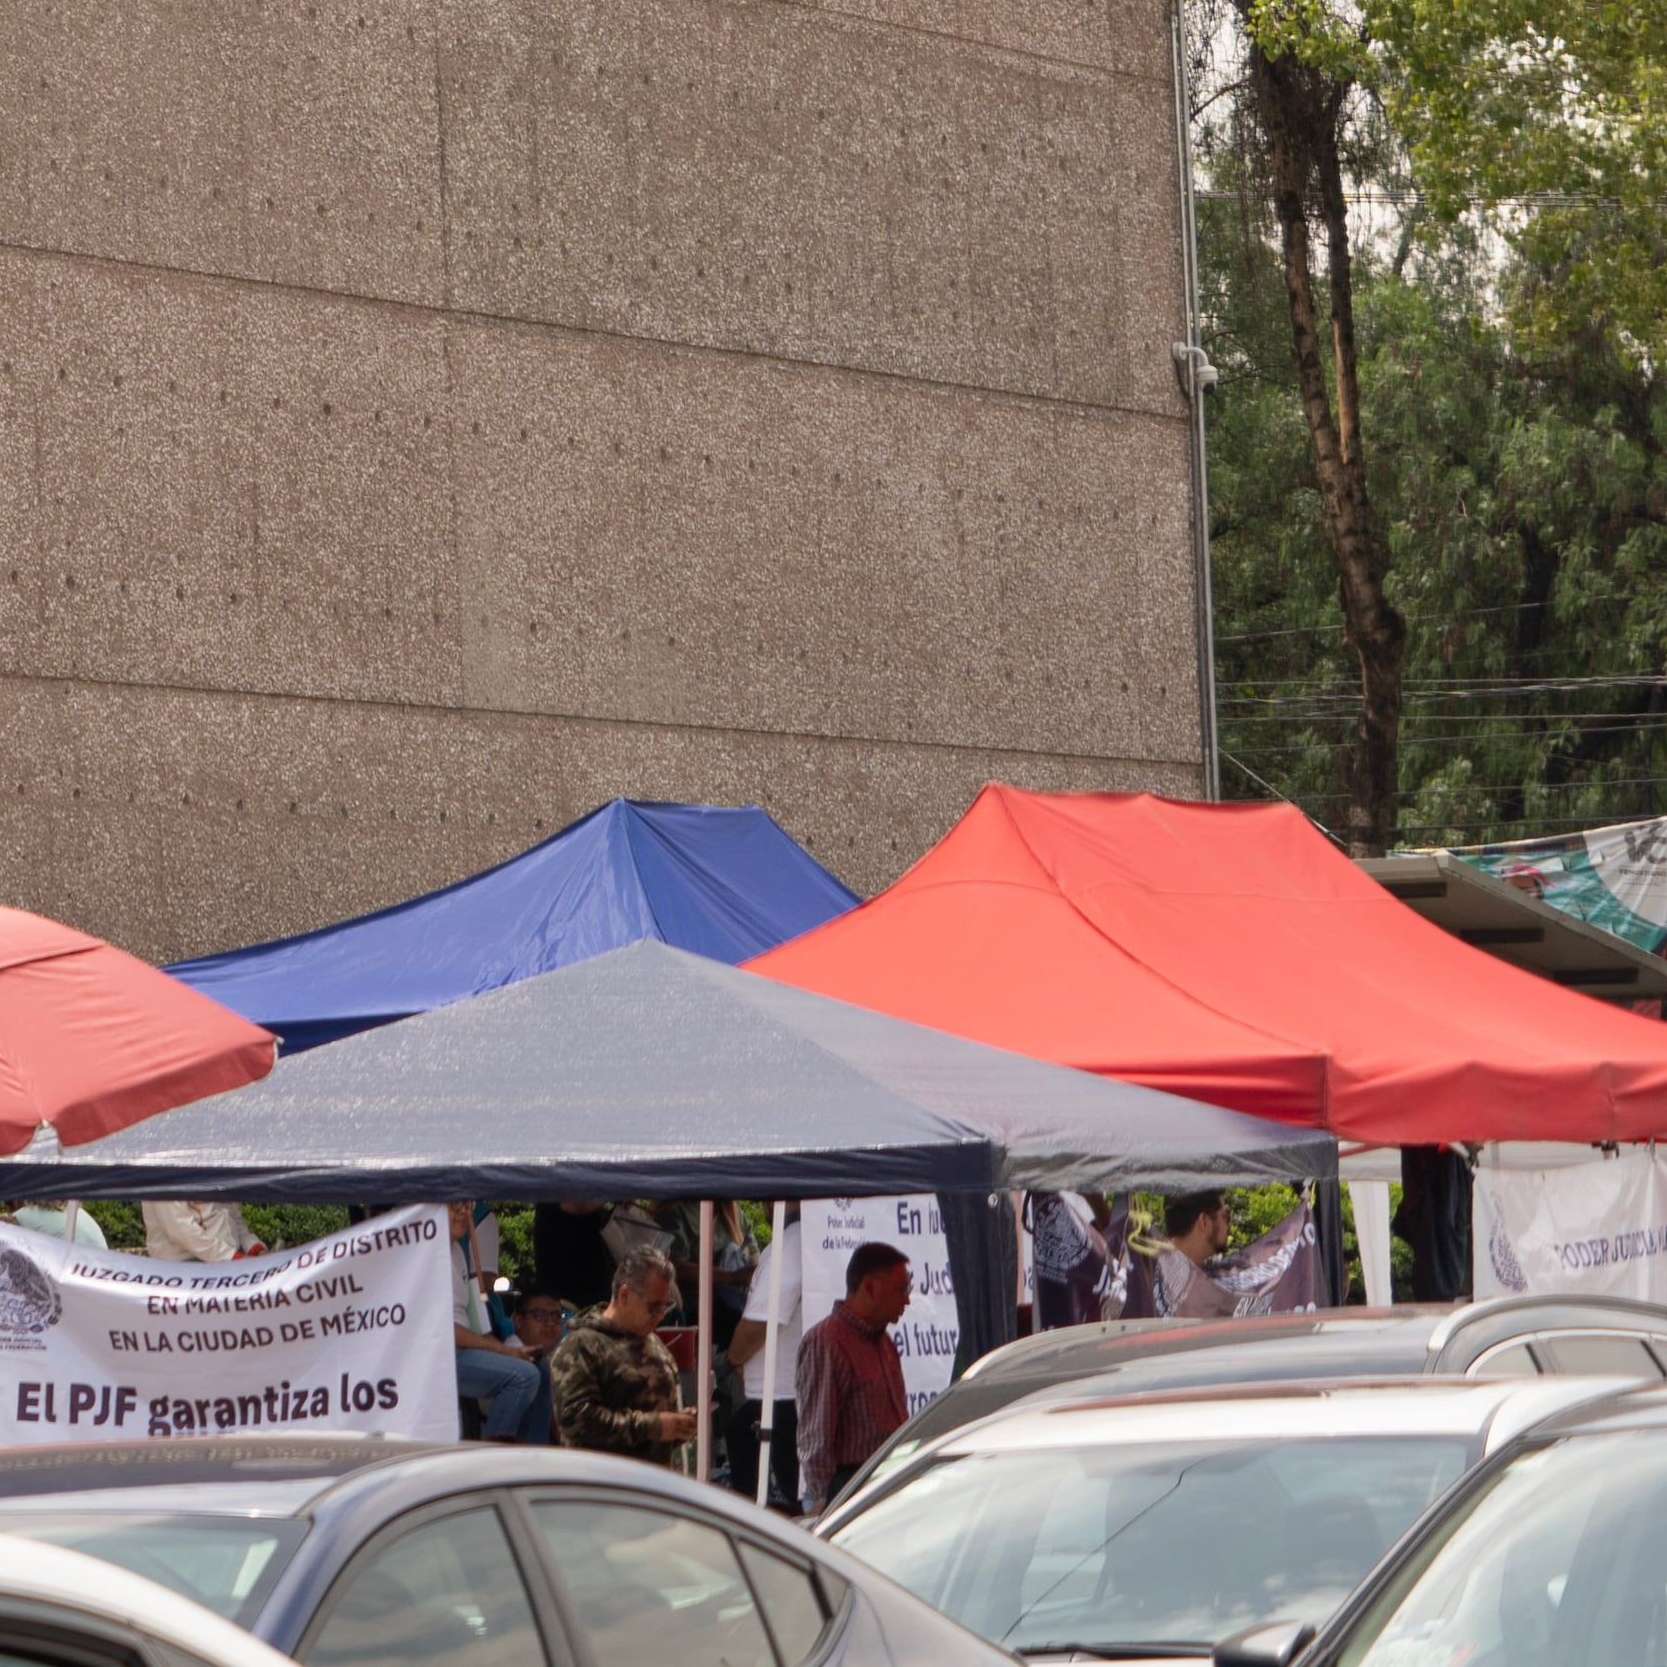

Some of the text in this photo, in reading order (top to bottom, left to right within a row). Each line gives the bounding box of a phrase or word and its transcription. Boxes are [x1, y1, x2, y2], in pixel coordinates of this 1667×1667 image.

[897, 1201, 922, 1235] En
[71, 1262, 184, 1289] JUZGADO
[190, 1258, 292, 1290] TERCERO
[296, 1245, 328, 1270] DE
[332, 1218, 438, 1261] DISTRITO
[822, 1236, 835, 1250] de
[147, 1273, 364, 1316] EN MATERIA CIVIL
[108, 1303, 407, 1353] EN LA CIUDAD DE MÉXICO
[16, 1371, 400, 1437] El PJF garantiza los
